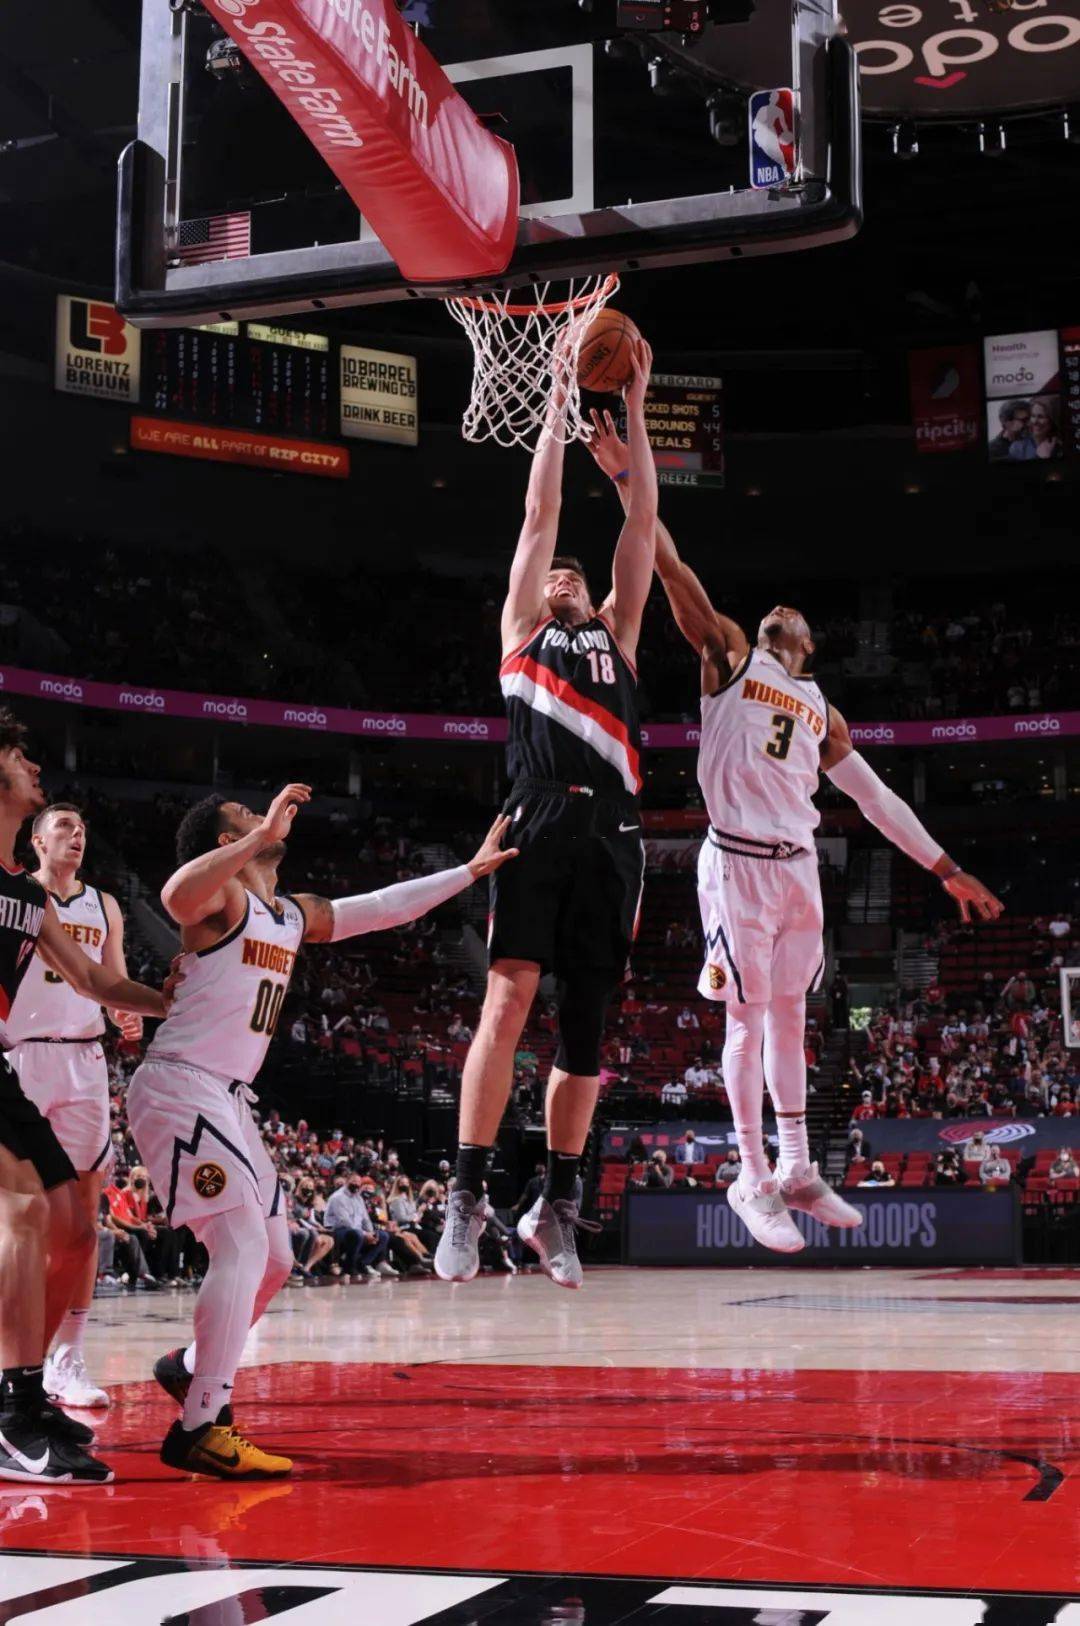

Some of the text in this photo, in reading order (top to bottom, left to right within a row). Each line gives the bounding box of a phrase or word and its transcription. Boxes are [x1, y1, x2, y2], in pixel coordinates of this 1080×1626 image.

[757, 166, 780, 183] NBA
[66, 354, 130, 376] LORENTZ
[66, 368, 130, 392] BRUUN
[992, 369, 1034, 384] moda
[343, 405, 415, 428] DRINK BEER
[671, 404, 700, 416] SHOTS
[712, 405, 720, 418] 5
[645, 417, 696, 431] EBOUNDS
[703, 422, 721, 433] 44
[138, 428, 160, 441] WE
[164, 431, 190, 445] ARE
[193, 436, 219, 450] ALL
[221, 441, 251, 454] PART
[269, 447, 299, 461] RIP
[300, 451, 340, 467] CITY
[650, 436, 720, 451] TEALS 5
[586, 650, 616, 685] 18
[40, 679, 83, 697] moda
[119, 691, 165, 707] moda
[203, 700, 248, 716] moda
[283, 709, 327, 724] moda
[742, 679, 825, 737] NUGGETS
[362, 716, 406, 731] moda
[443, 721, 489, 735] moda
[932, 723, 977, 738] moda
[1014, 717, 1060, 732] moda
[765, 713, 796, 760] 3
[850, 726, 894, 740] moda
[0, 895, 45, 938] RTLAND
[61, 922, 102, 948] GETS
[241, 937, 297, 976] NUGGET
[249, 978, 285, 1036] 00
[696, 1203, 754, 1248] HOO
